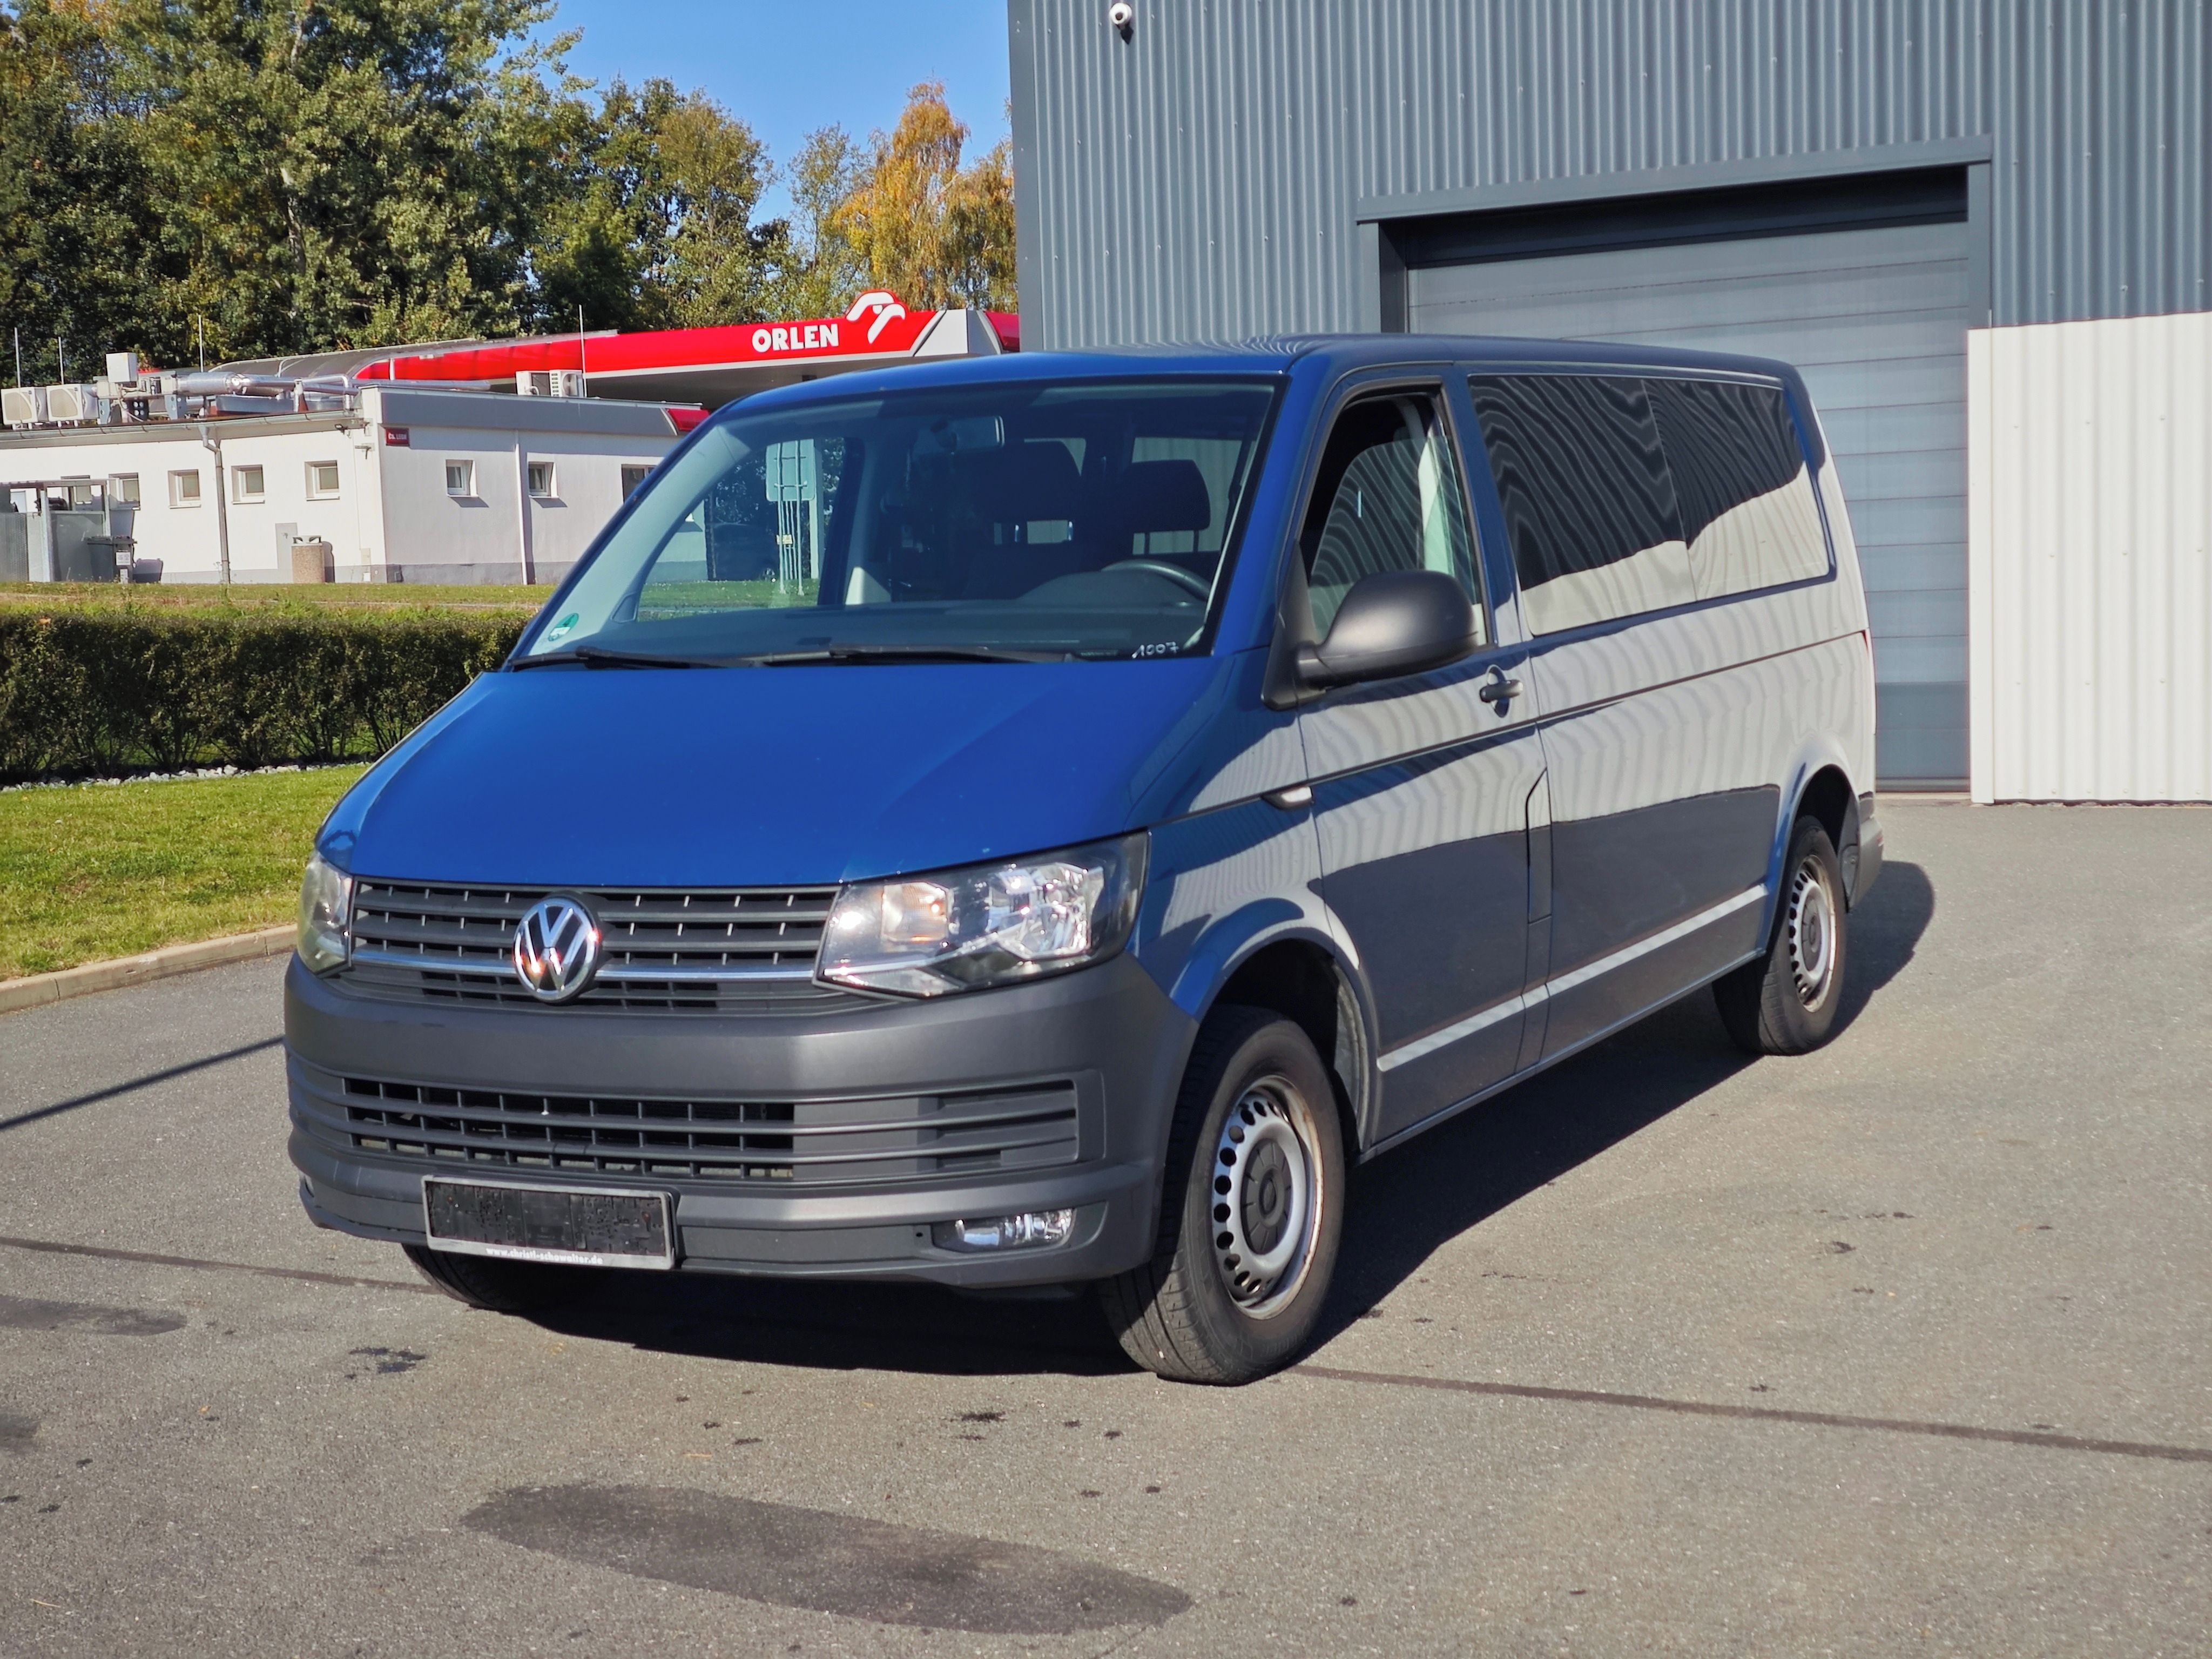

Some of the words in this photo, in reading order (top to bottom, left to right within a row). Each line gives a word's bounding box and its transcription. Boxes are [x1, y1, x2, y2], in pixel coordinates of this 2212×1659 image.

[752, 323, 839, 352] ORLEN
[1132, 642, 1179, 658] 1007
[515, 899, 594, 998] VW
